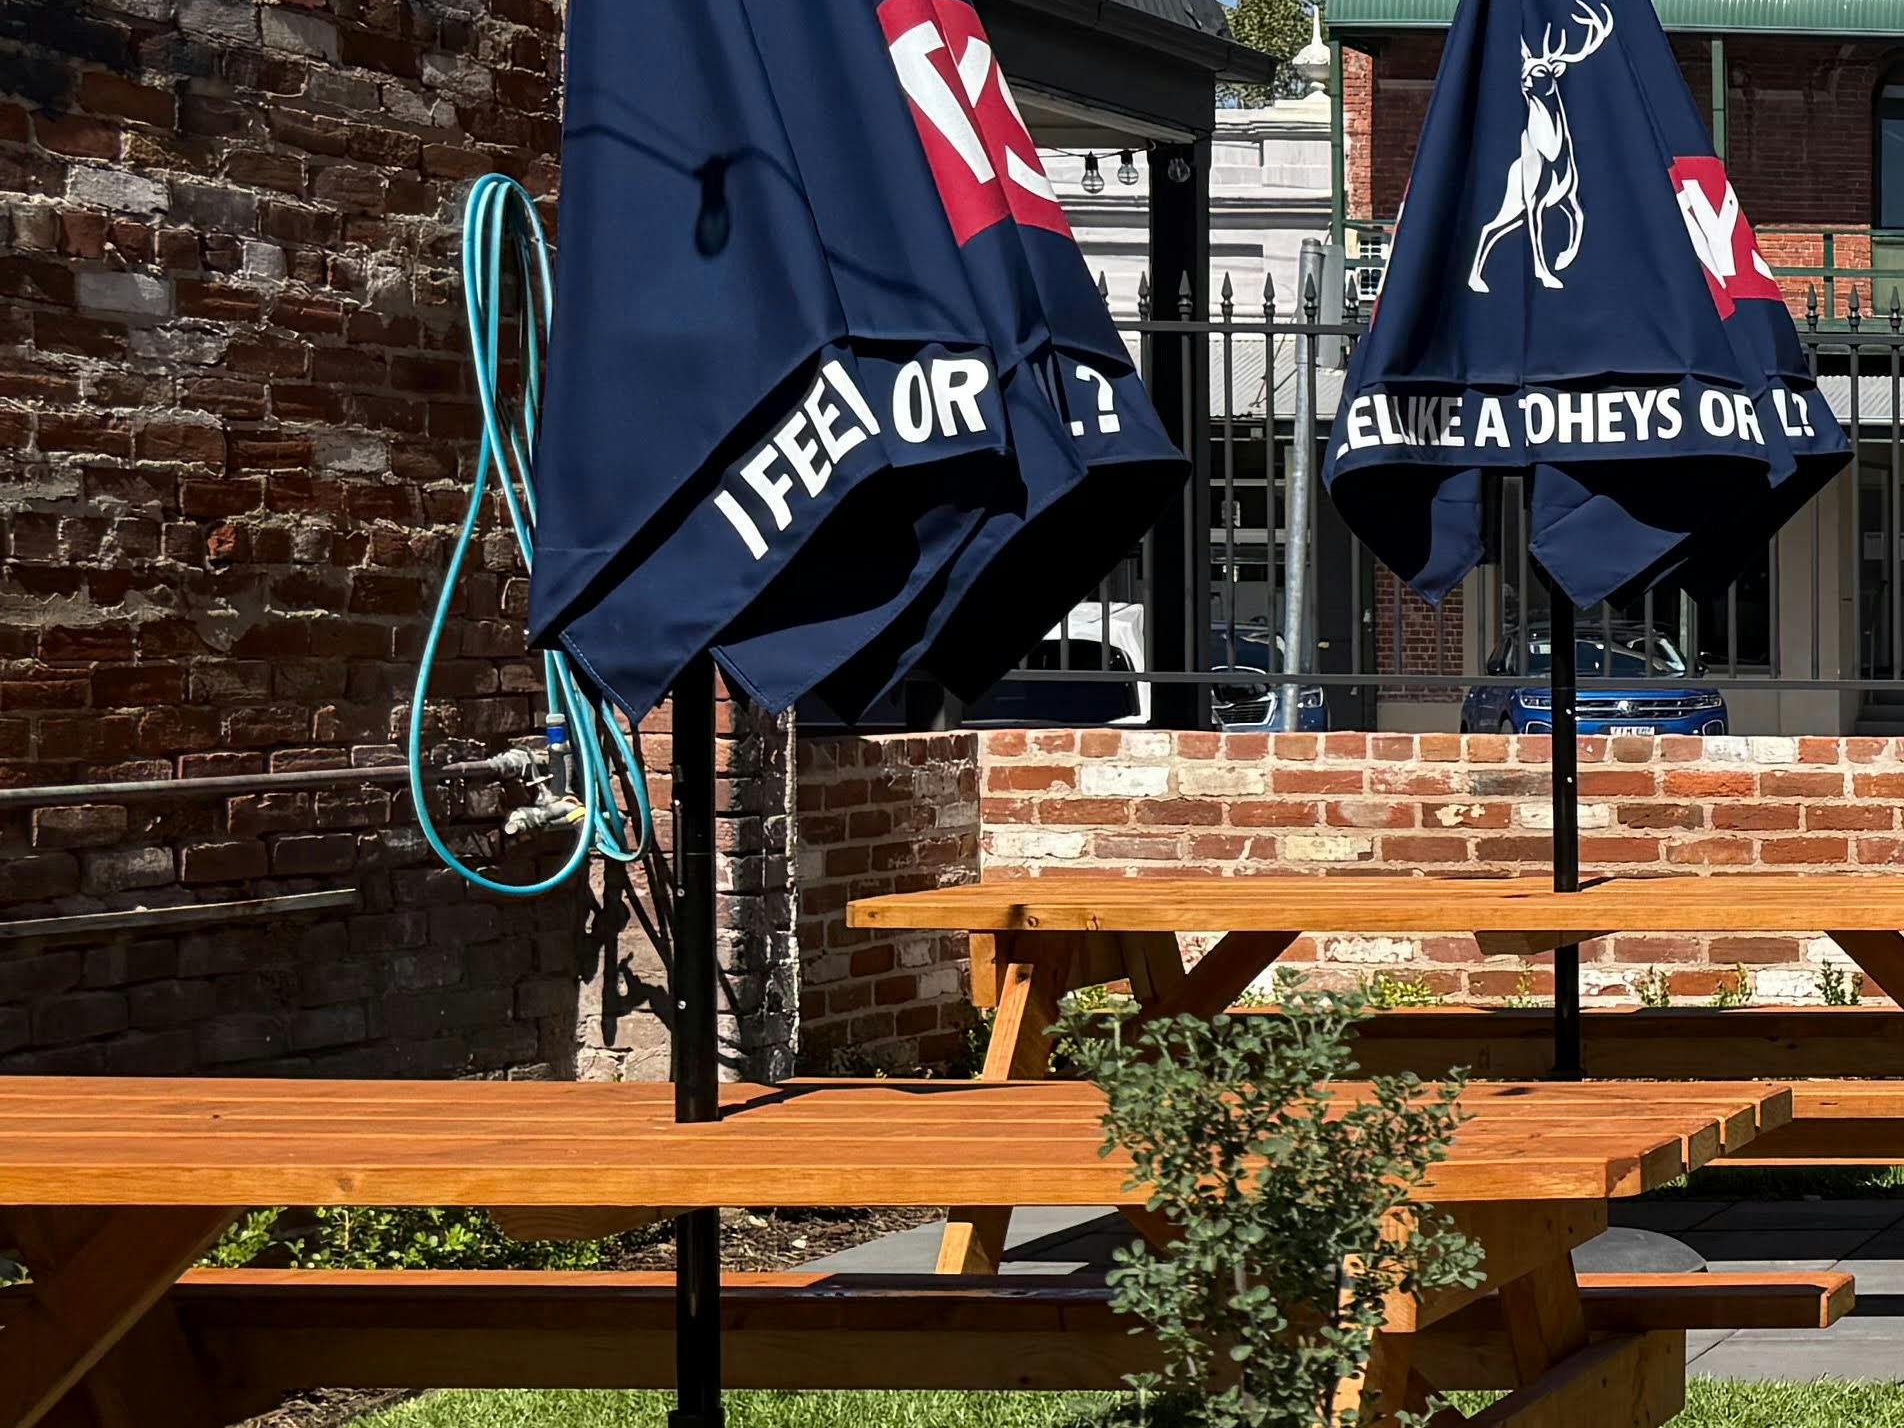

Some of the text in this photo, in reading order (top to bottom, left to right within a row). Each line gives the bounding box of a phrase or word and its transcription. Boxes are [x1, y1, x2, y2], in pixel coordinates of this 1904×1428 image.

[892, 358, 990, 444] OR
[1474, 397, 1512, 449] A
[1517, 387, 1684, 448] OHEYS
[714, 489, 769, 561] I
